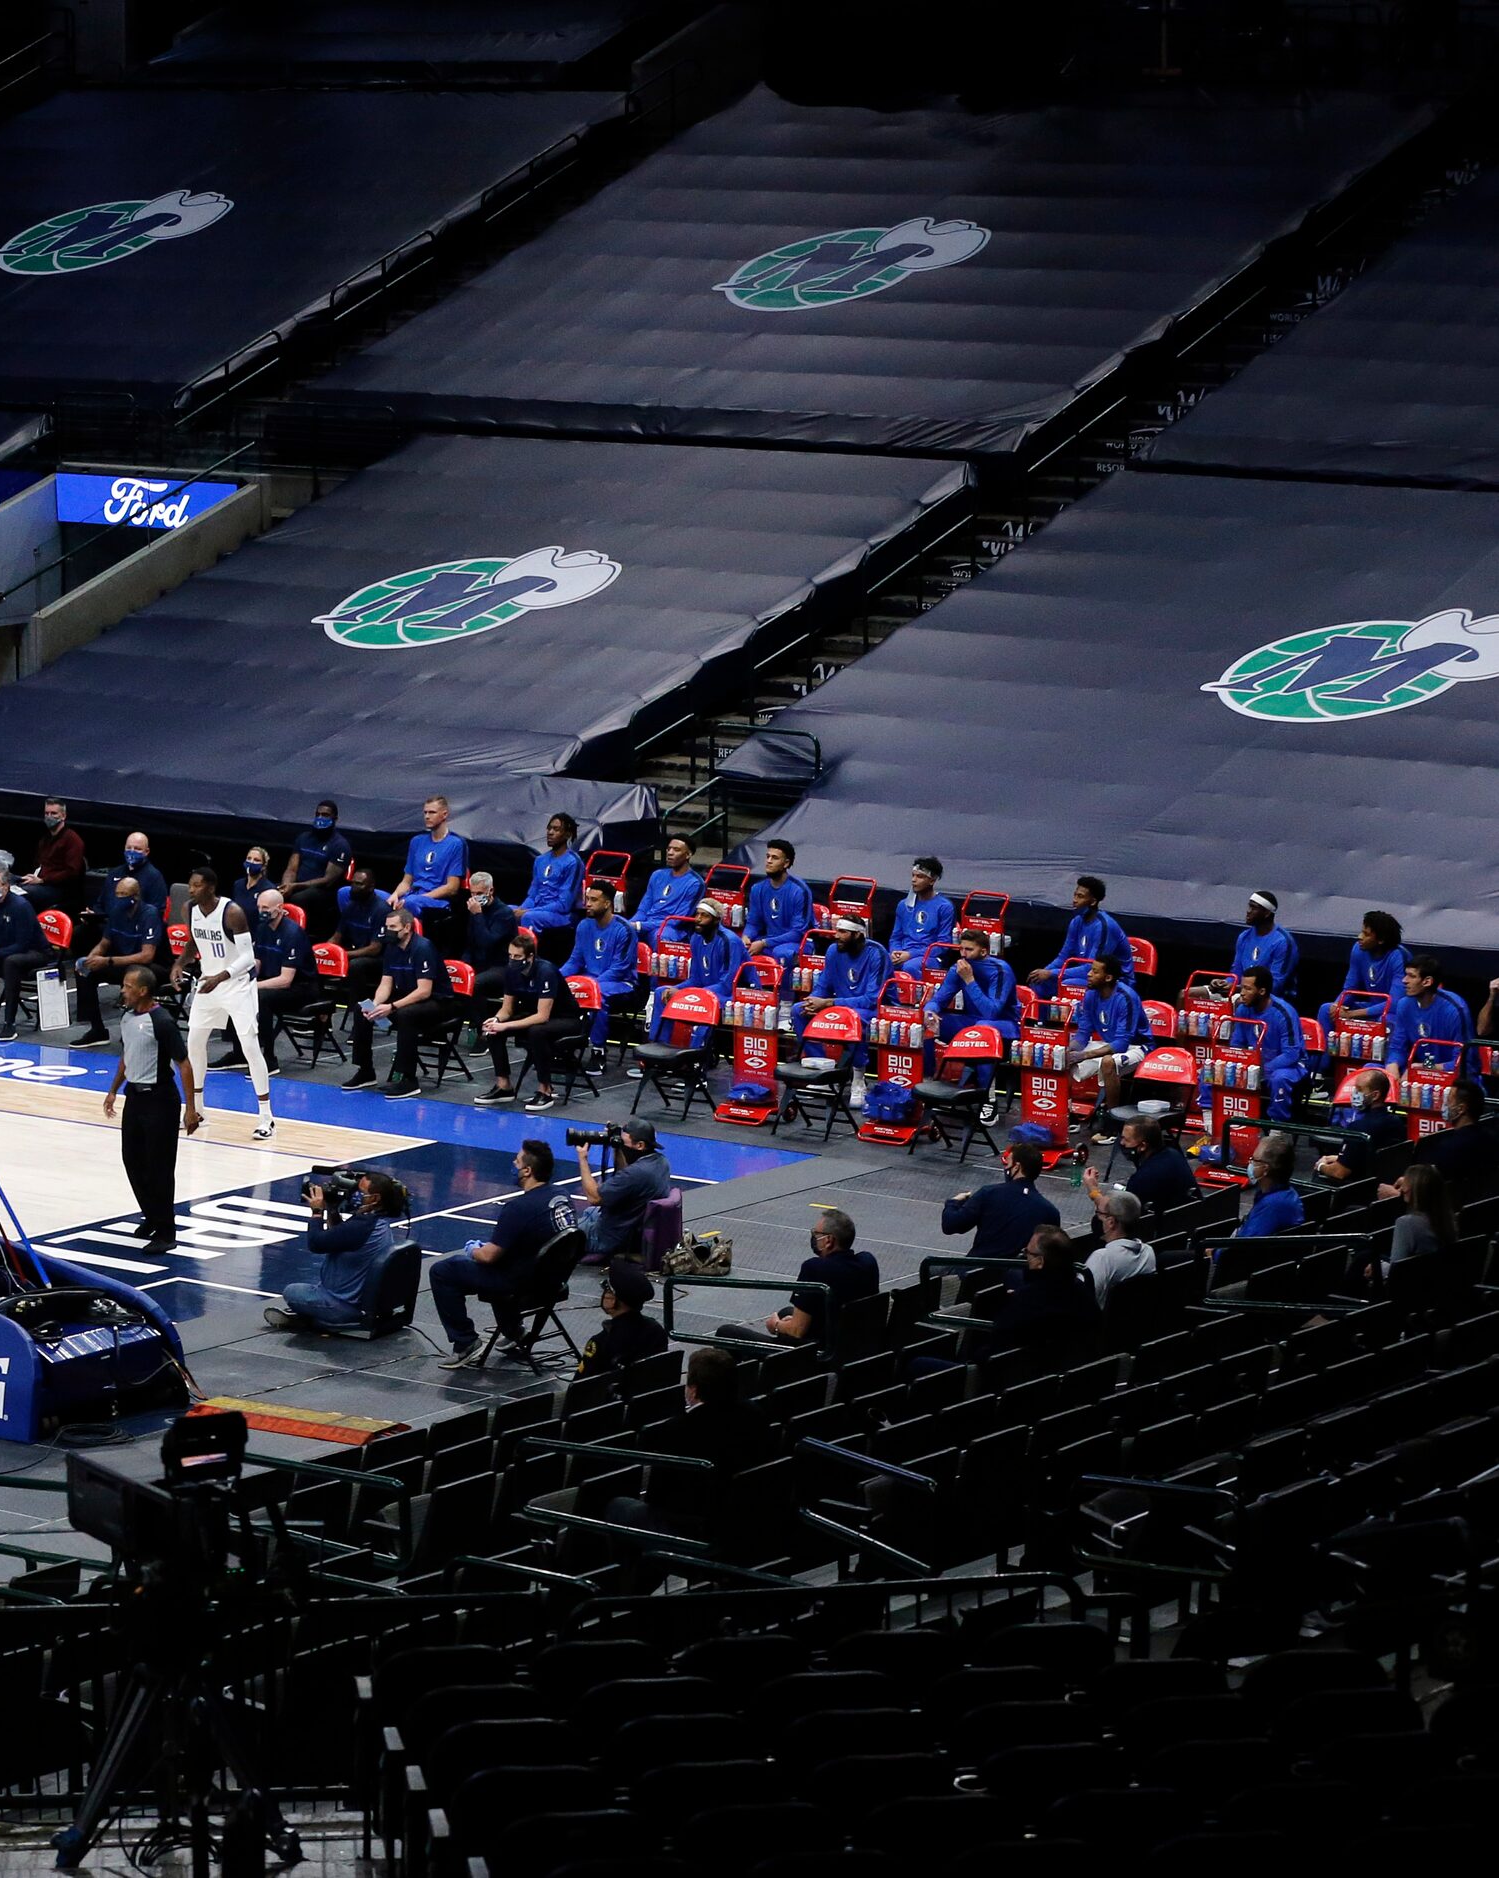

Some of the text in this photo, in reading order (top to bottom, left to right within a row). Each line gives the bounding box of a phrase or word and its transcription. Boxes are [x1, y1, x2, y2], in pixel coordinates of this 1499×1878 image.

[104, 477, 190, 529] Ford
[193, 927, 222, 941] DALLAS
[211, 942, 226, 959] 10
[671, 1002, 709, 1014] BIOSTEEL
[812, 1021, 849, 1031] BIOSTEEL
[743, 1036, 768, 1050] BIO
[952, 1040, 990, 1048] BIOSTEEL
[743, 1050, 768, 1058] STEEL
[888, 1054, 913, 1069] BIO
[1143, 1061, 1184, 1073] BIOSTEEL
[1032, 1076, 1057, 1091] BIO
[1032, 1090, 1057, 1098] STEEL
[1223, 1096, 1249, 1111] BIO
[1223, 1110, 1249, 1118] STEEL
